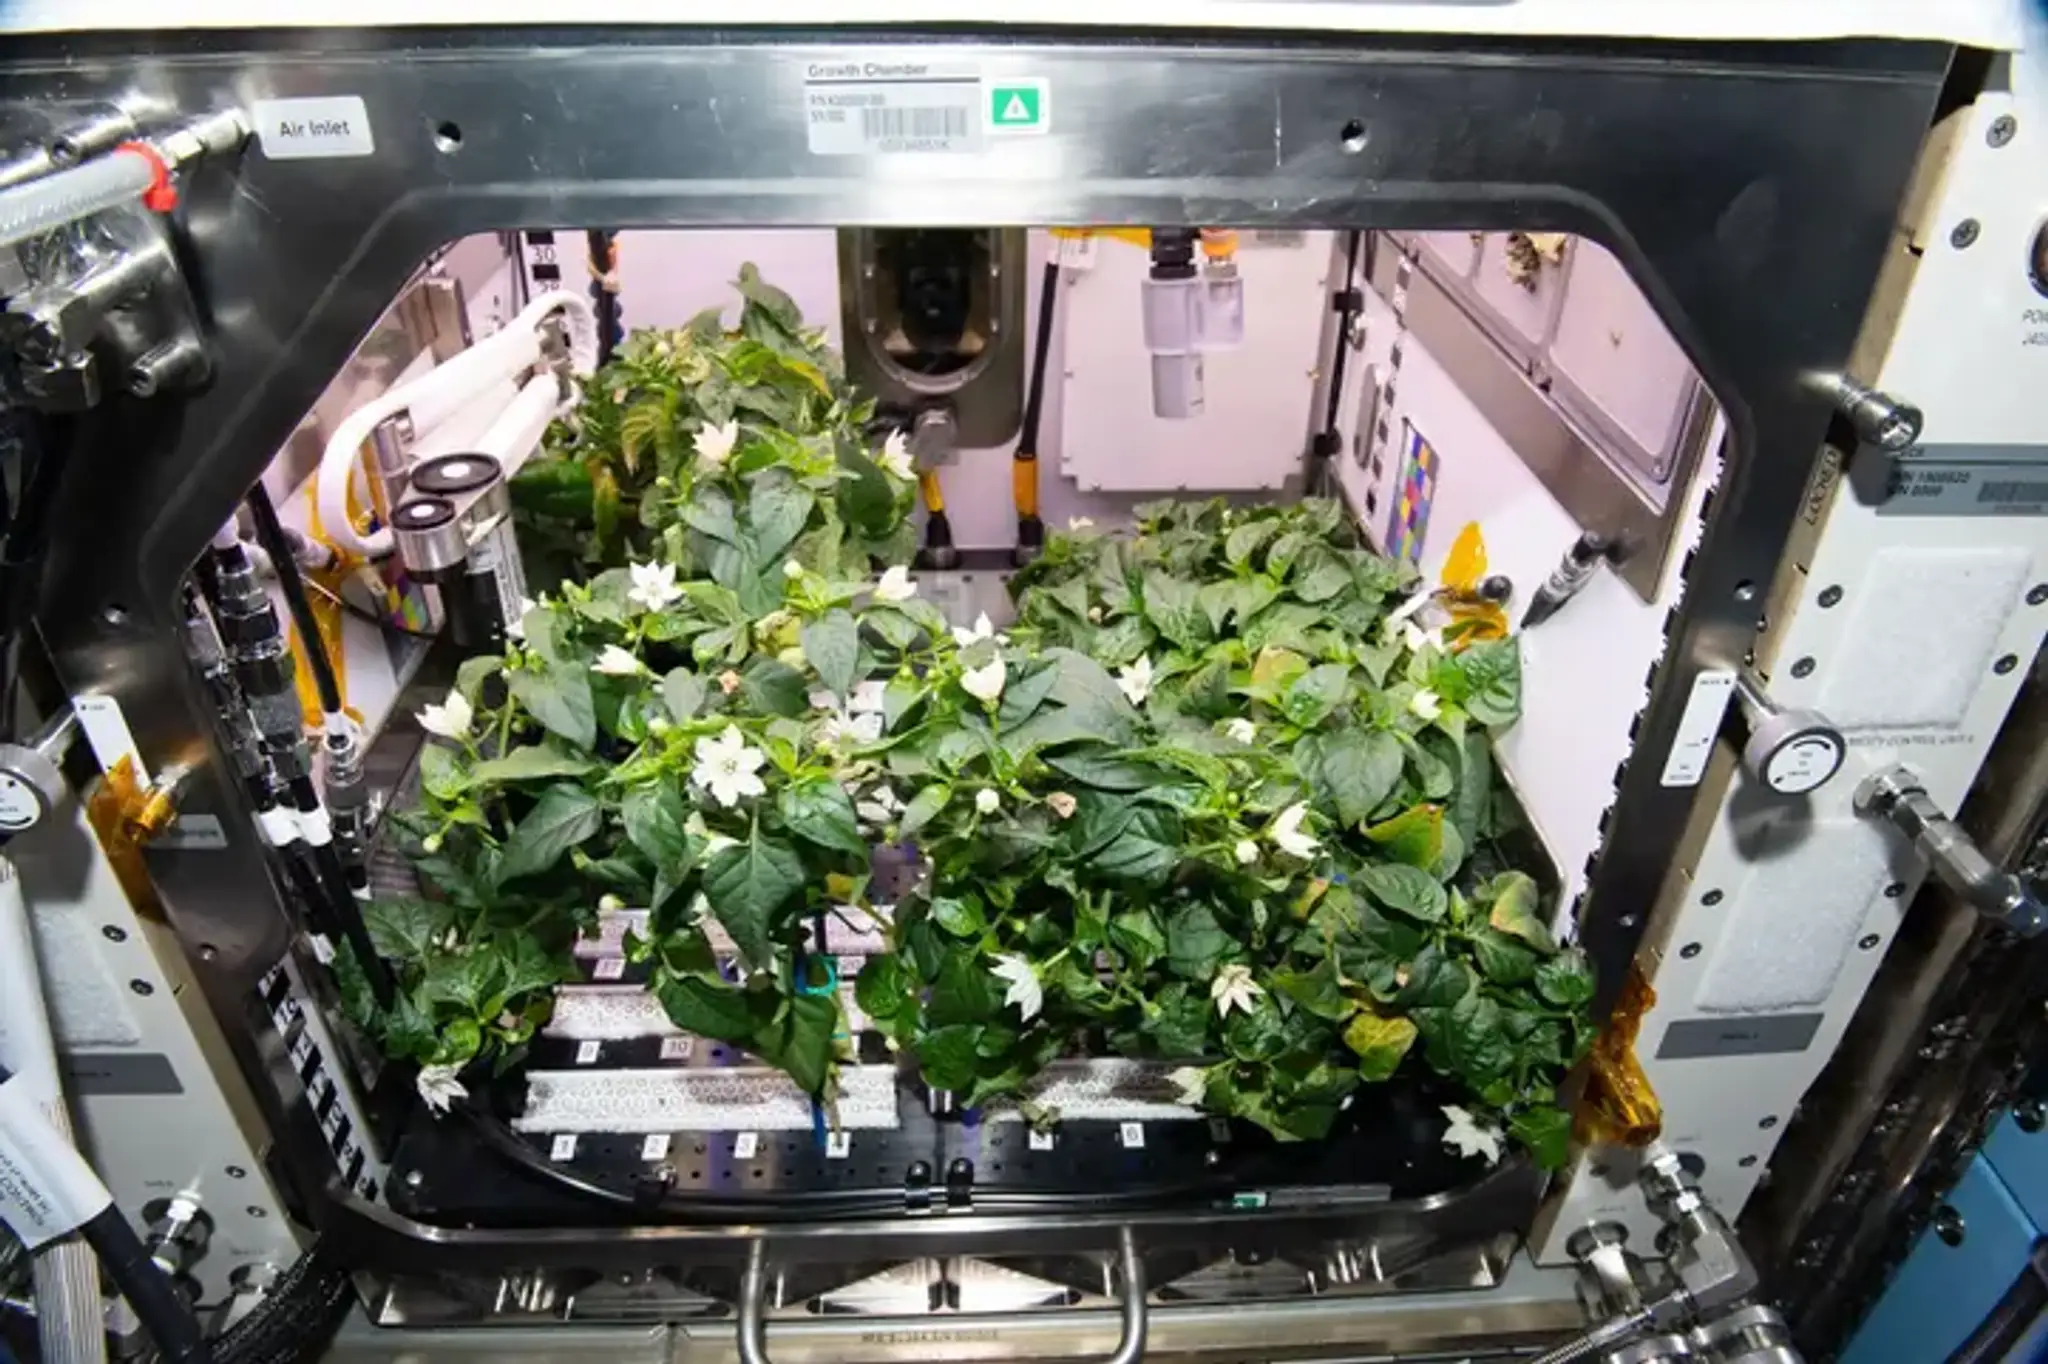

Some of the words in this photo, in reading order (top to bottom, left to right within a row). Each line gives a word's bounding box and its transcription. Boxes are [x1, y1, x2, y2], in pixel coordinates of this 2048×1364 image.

[808, 63, 860, 78] Growth
[864, 62, 929, 76] Chamber
[280, 121, 304, 138] Air
[309, 119, 350, 137] Inlet
[669, 1038, 689, 1054] 10
[1125, 1125, 1139, 1142] 6
[647, 1137, 660, 1153] 2
[738, 1136, 751, 1153] 3
